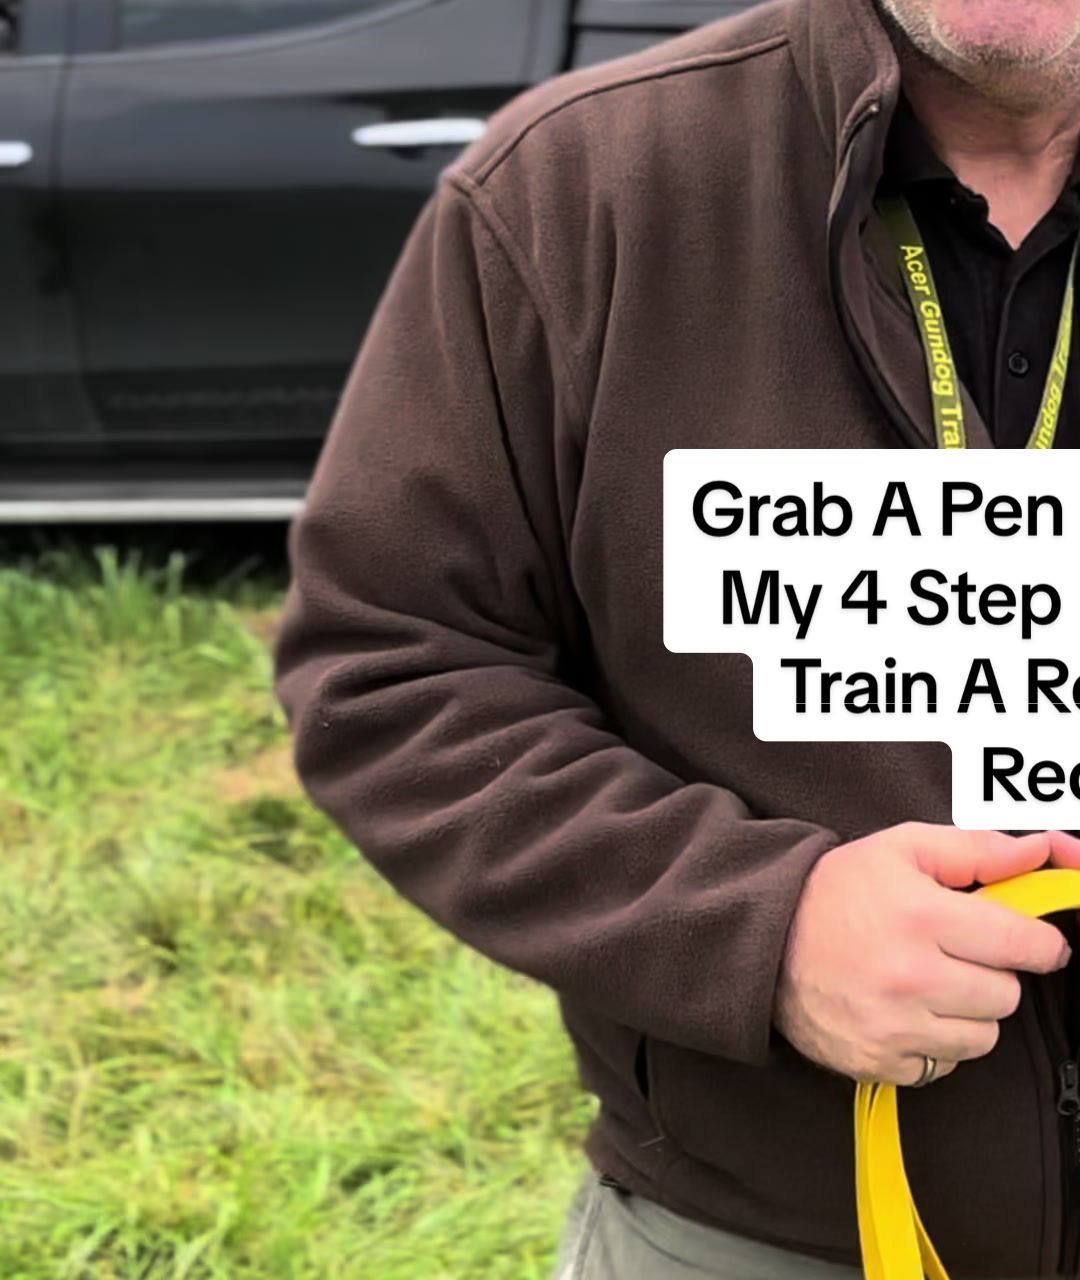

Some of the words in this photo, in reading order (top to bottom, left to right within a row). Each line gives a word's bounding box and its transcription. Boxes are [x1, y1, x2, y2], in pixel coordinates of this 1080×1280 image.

[900, 245, 931, 296] Acer
[920, 300, 954, 396] Gundog
[941, 403, 963, 448] Tra
